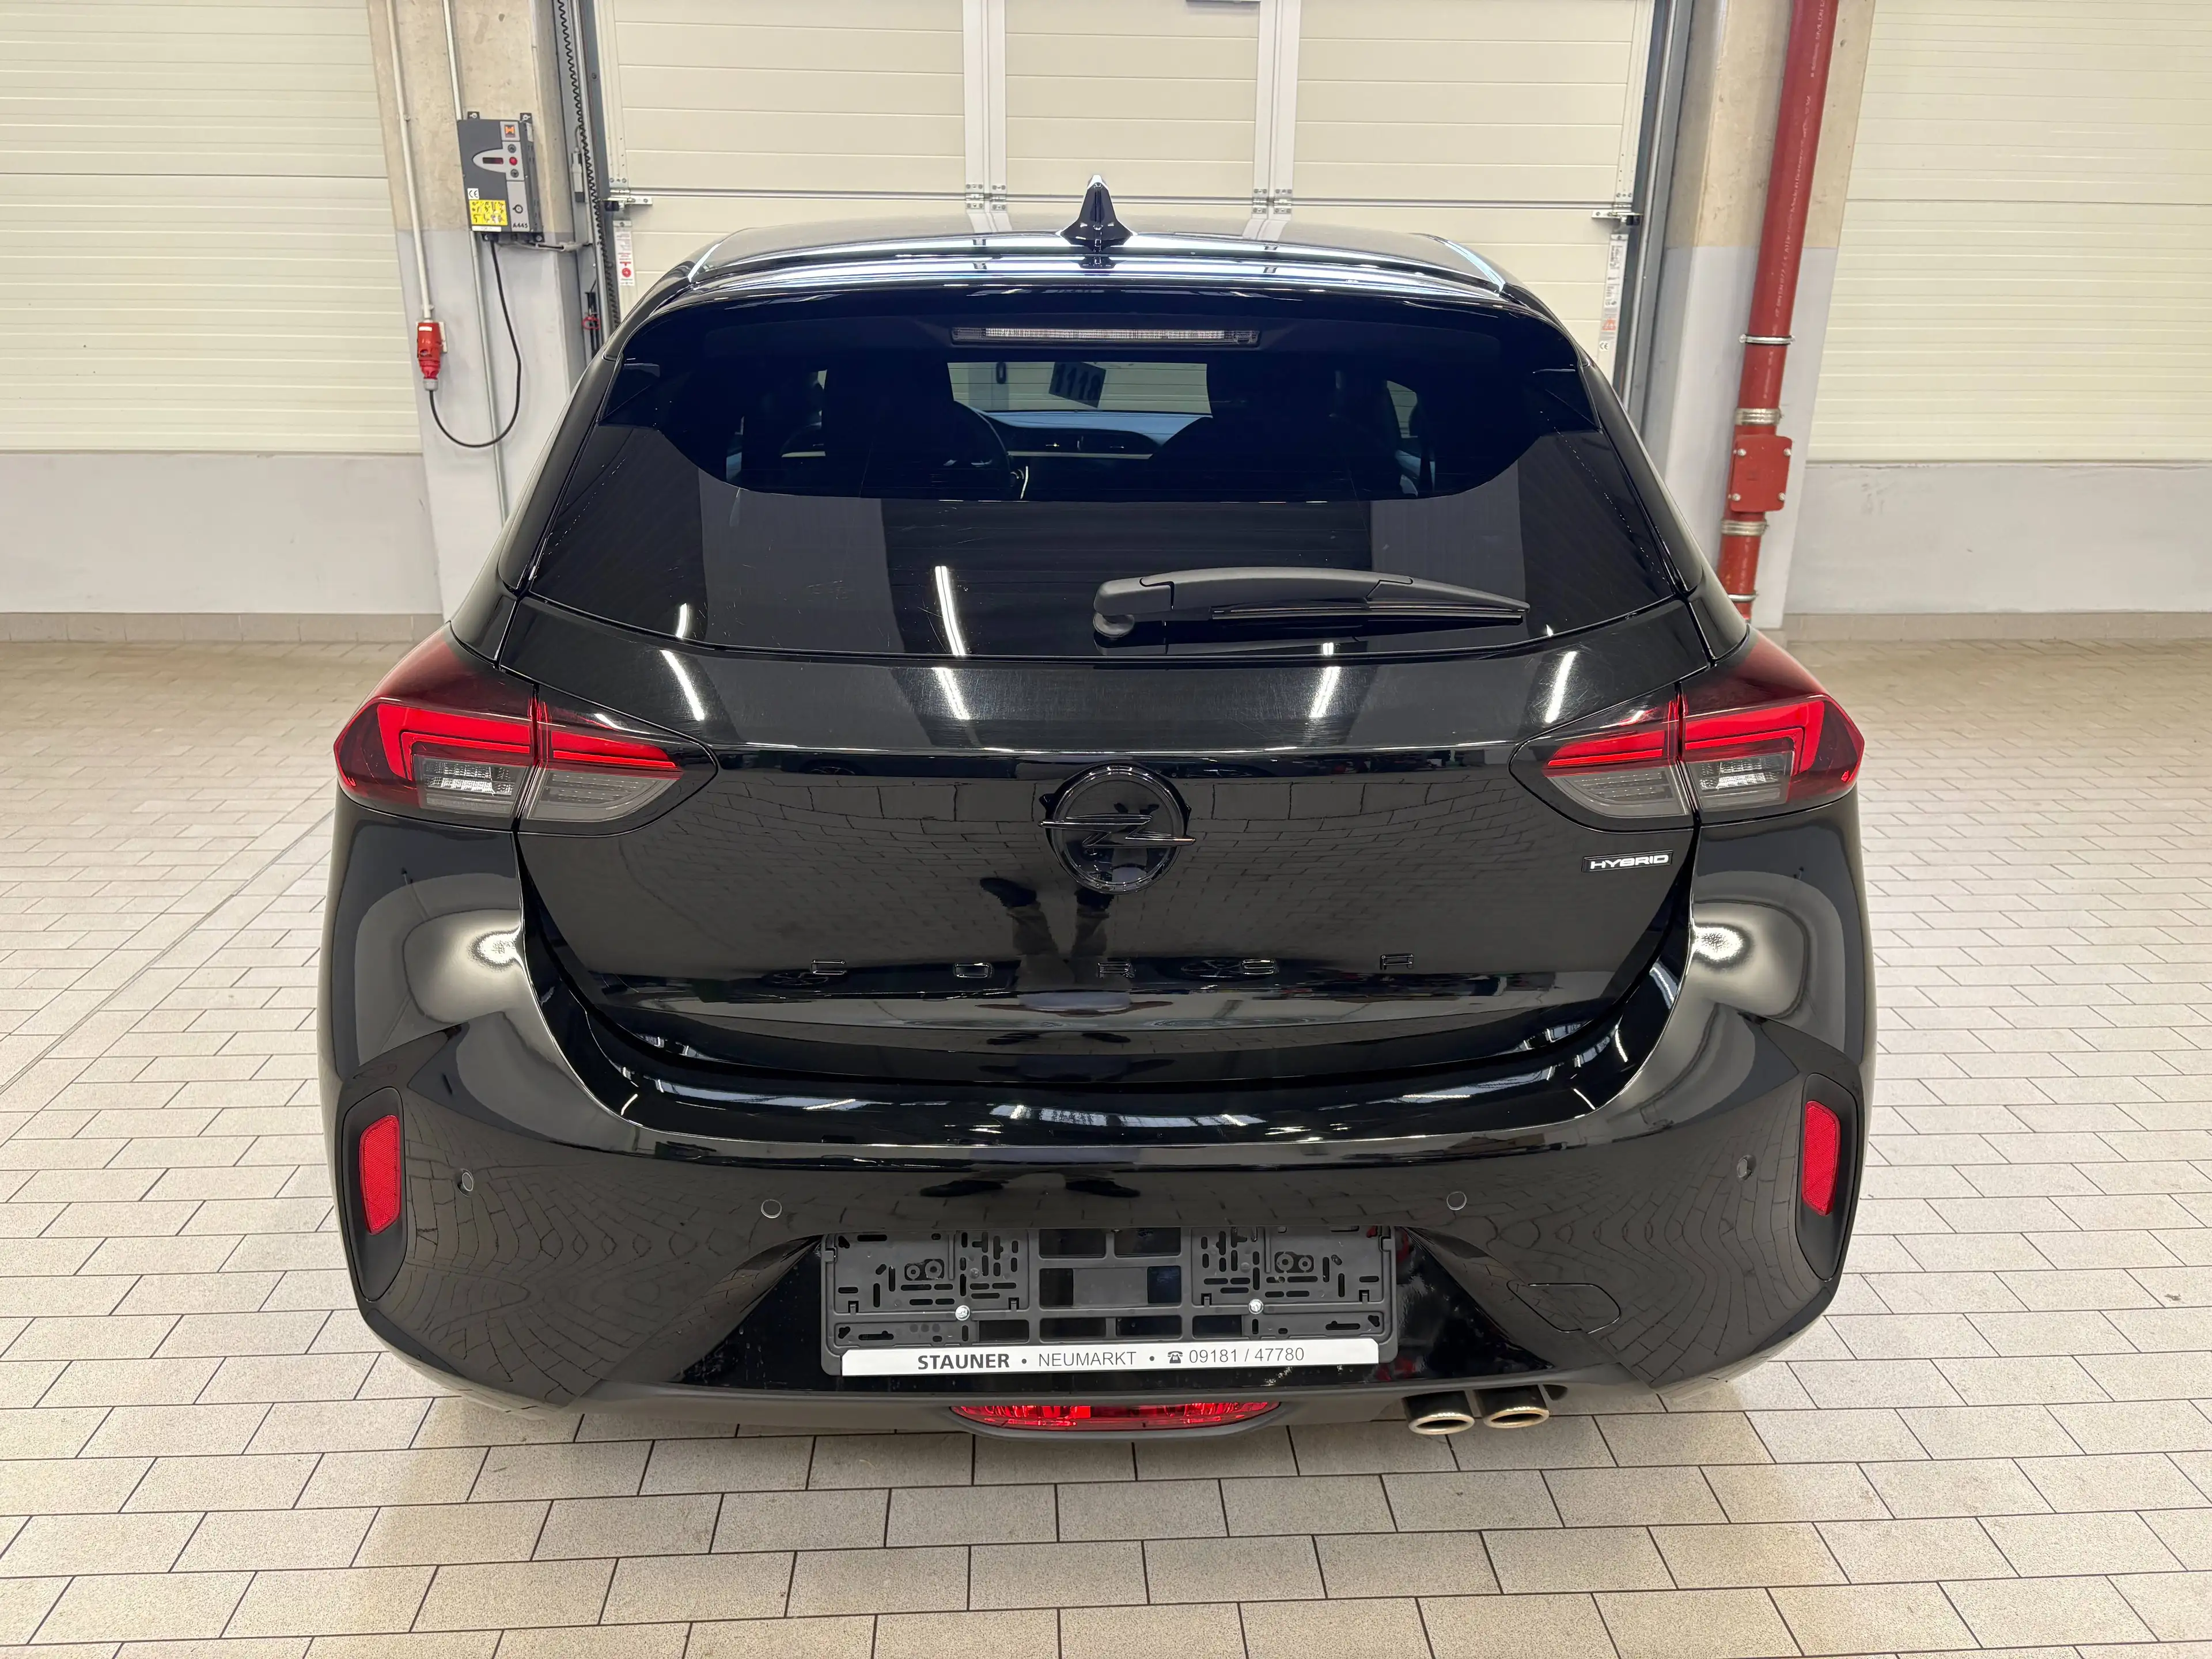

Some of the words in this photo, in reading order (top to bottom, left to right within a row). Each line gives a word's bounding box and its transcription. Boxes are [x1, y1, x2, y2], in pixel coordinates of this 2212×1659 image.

[1590, 854, 1669, 869] HYBRID
[811, 953, 1415, 979] CORSA
[918, 1354, 1010, 1370] STAUNER
[1039, 1351, 1137, 1366] NEUMARKT
[1189, 1349, 1237, 1363] 09181
[1244, 1349, 1249, 1362] /
[1255, 1347, 1305, 1361] 47780
